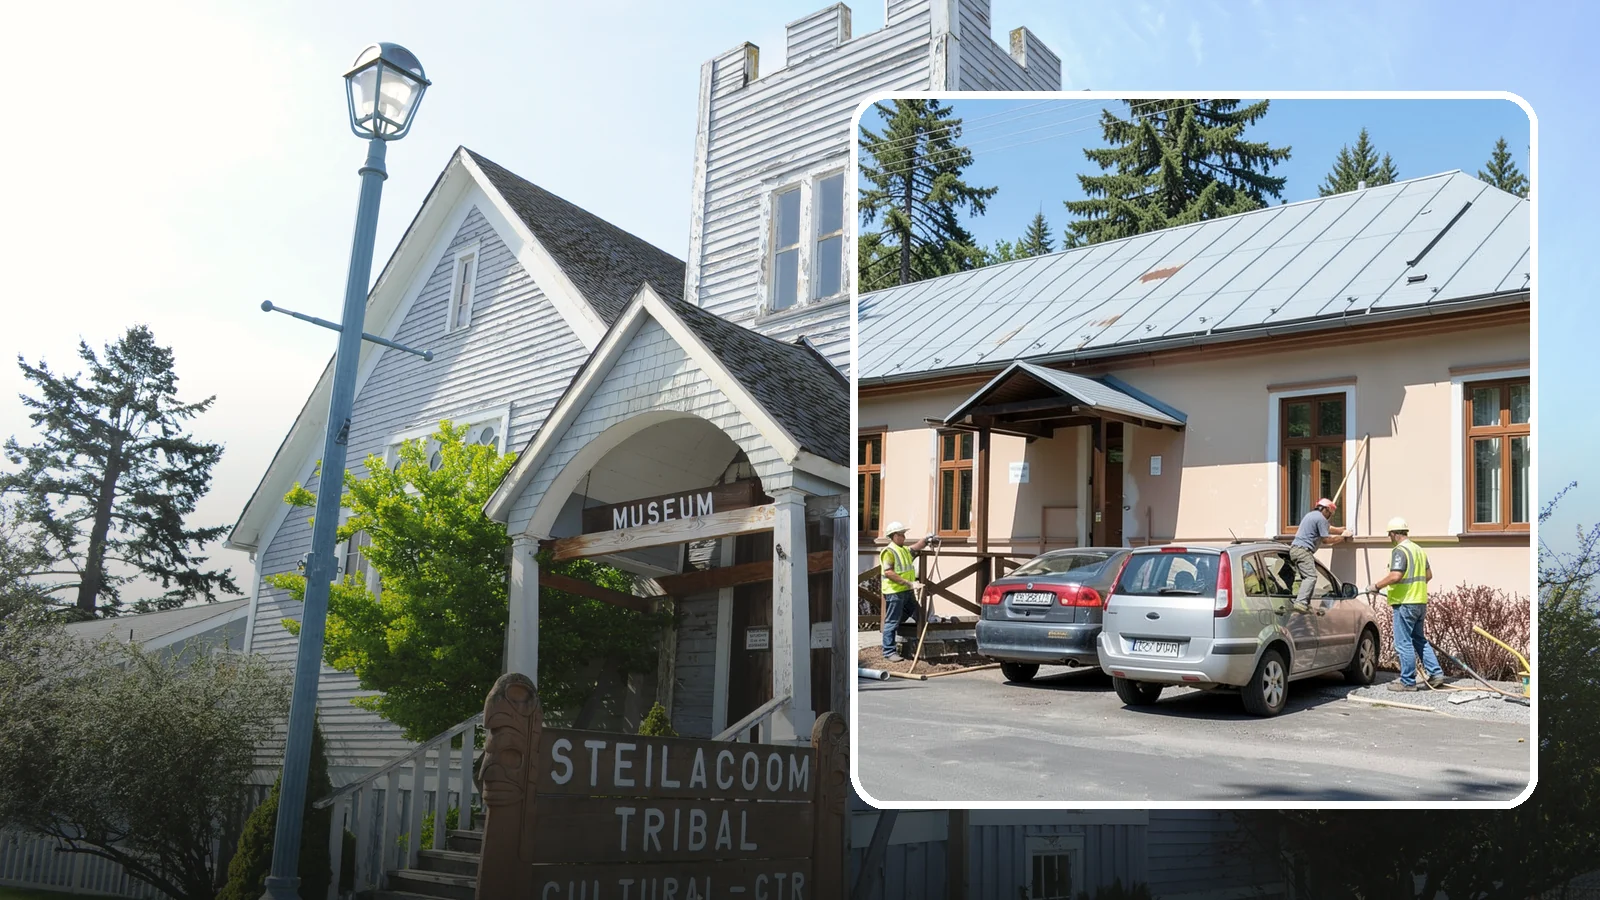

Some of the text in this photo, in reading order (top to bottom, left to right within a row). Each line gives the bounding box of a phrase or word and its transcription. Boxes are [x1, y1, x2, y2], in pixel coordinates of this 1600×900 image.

[613, 491, 713, 531] MUSEUM
[550, 738, 809, 792] STEILACOOM
[614, 806, 758, 852] TRIBAL
